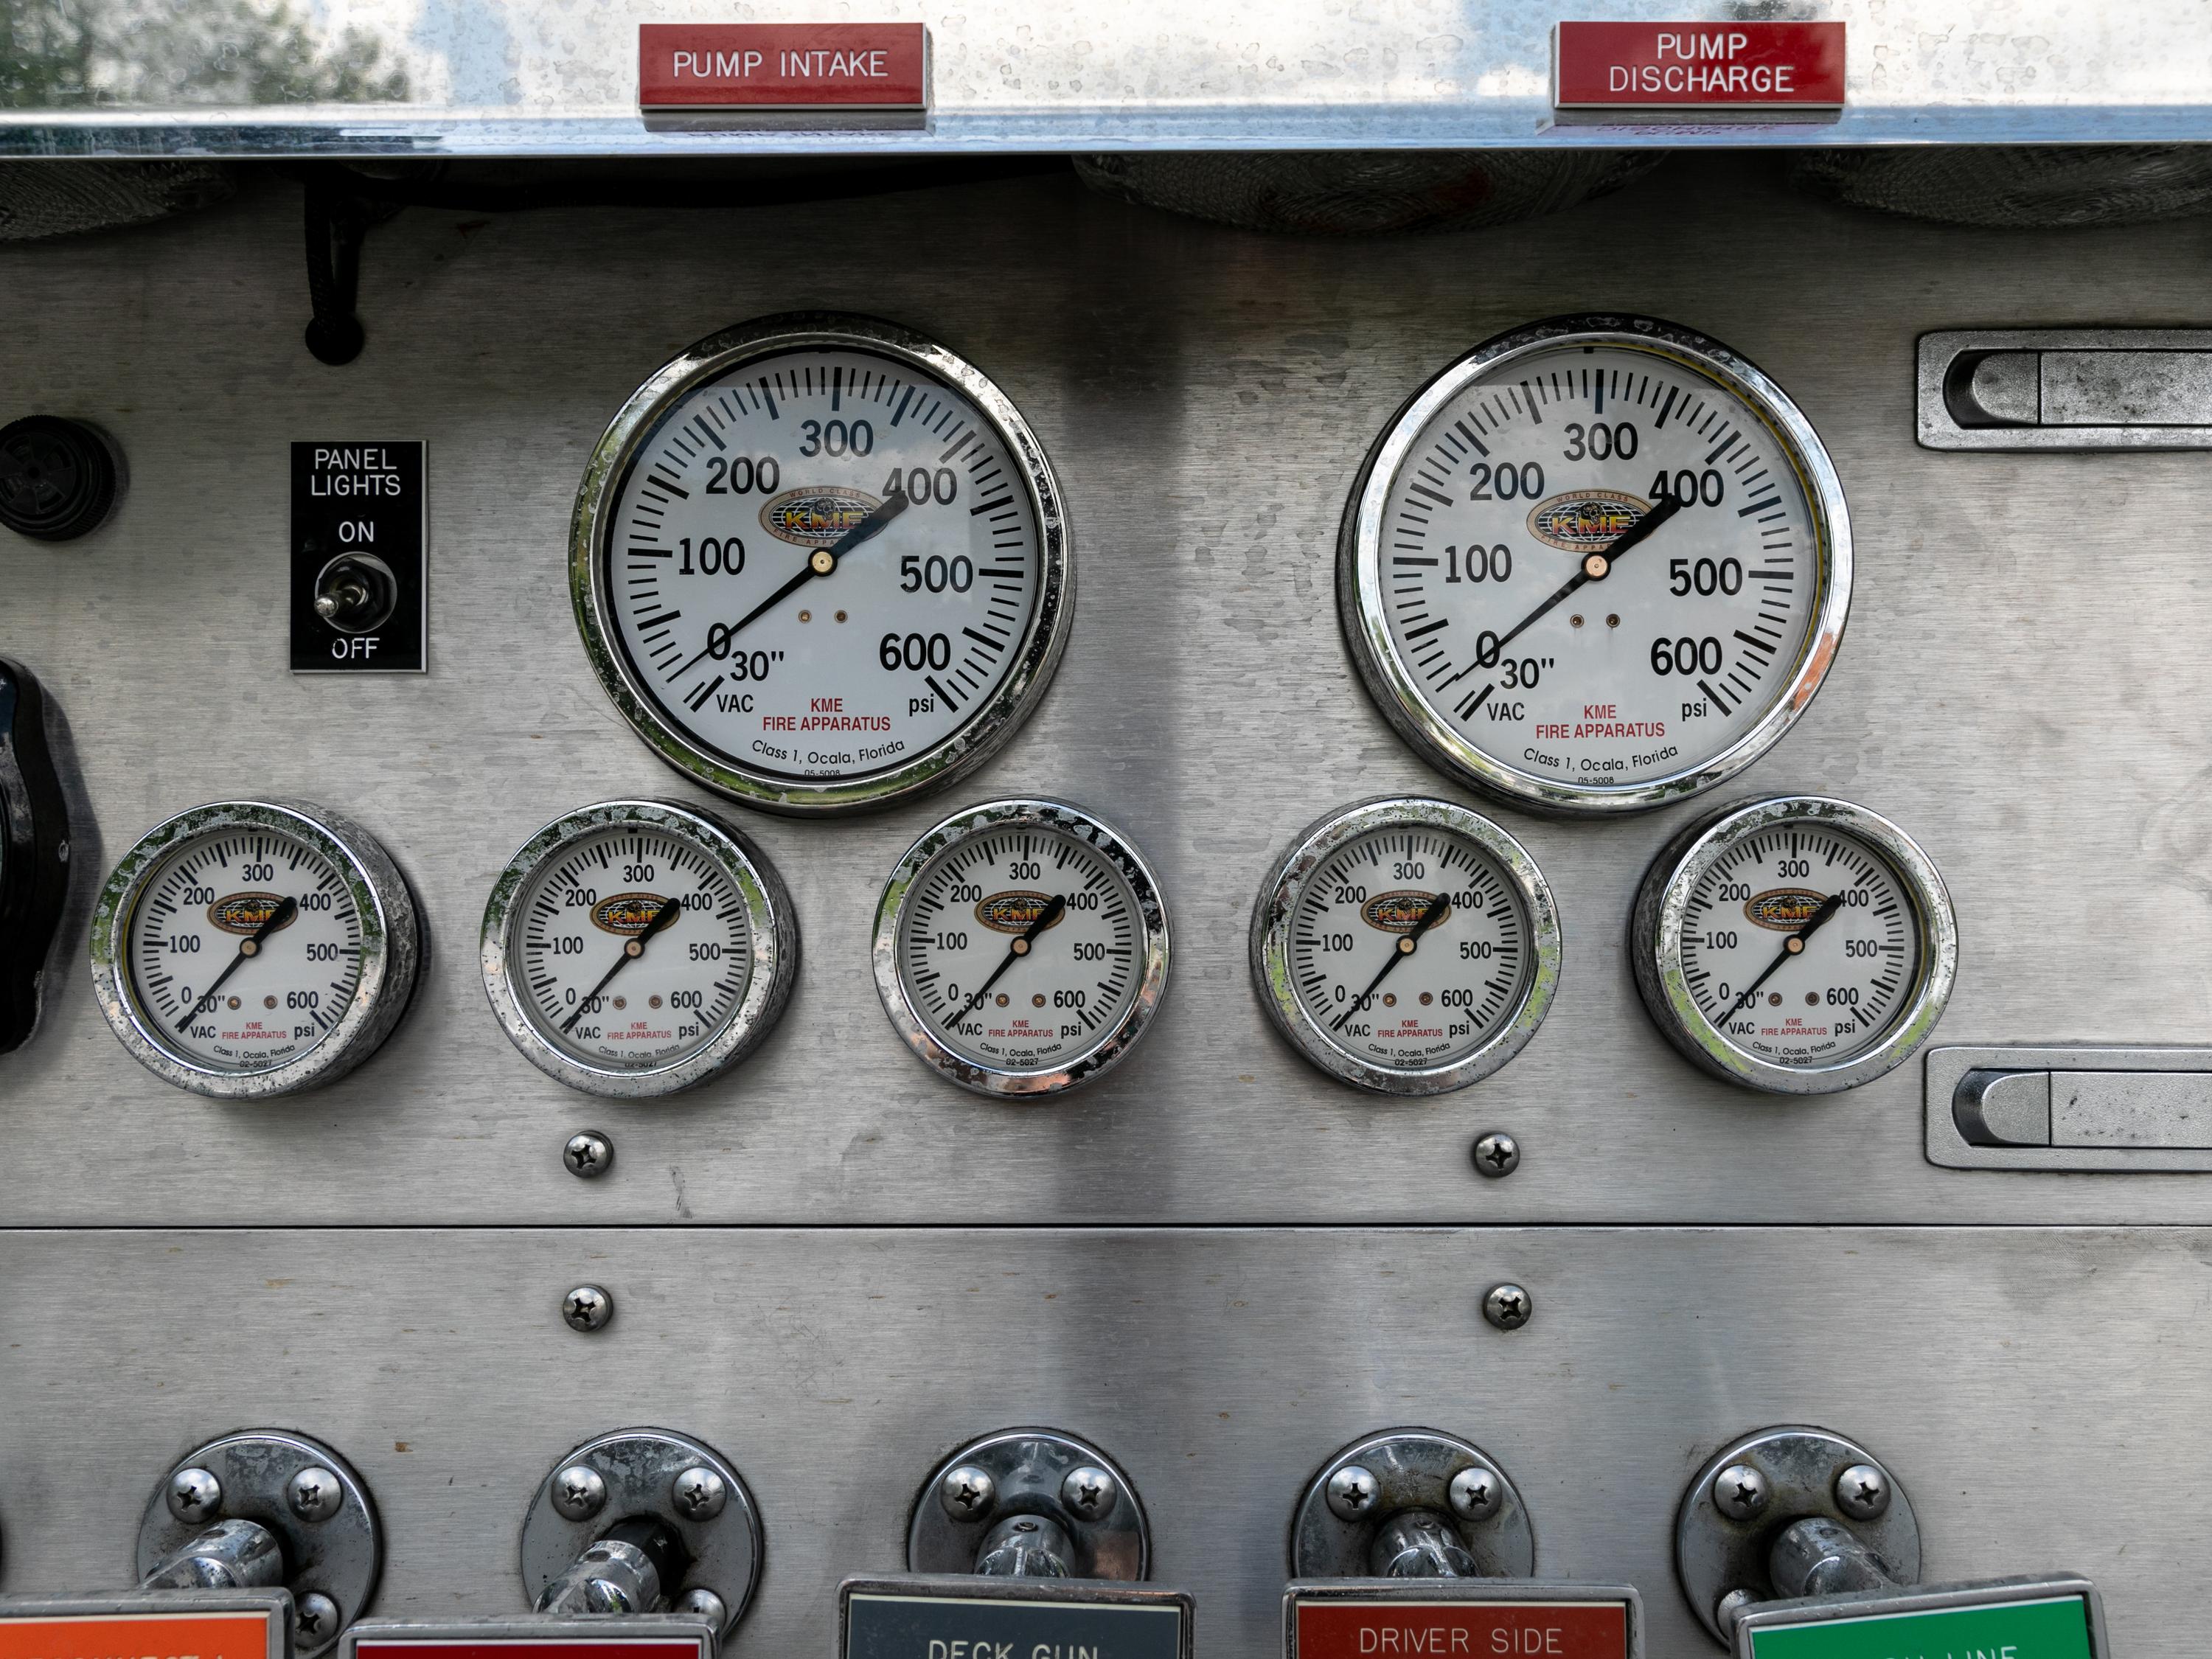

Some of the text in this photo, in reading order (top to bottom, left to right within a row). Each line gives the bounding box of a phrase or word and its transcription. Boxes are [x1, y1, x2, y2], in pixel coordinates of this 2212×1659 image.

[1657, 32, 1747, 60] PUMP
[673, 50, 888, 77] PUMP INTAKE
[1610, 66, 1795, 93] DISCHARGE
[799, 418, 874, 458] 300
[1562, 422, 1638, 461] 300
[315, 448, 397, 470] PANEL
[706, 456, 779, 495] 200
[1469, 462, 1545, 501] 200
[311, 475, 401, 496] LIGHTS
[789, 488, 860, 498] WORLD CLASS
[882, 467, 957, 505] 400
[1648, 469, 1724, 508] 400
[1557, 493, 1629, 503] WORLD CLASS
[785, 511, 863, 529] KME
[1552, 515, 1630, 535] KME
[338, 521, 374, 543] ON
[774, 529, 798, 542] FIRE
[1541, 535, 1565, 548] FIRE
[678, 537, 745, 576] 100
[1444, 544, 1512, 583] 100
[900, 554, 973, 594] 500
[1669, 557, 1742, 597] 500
[332, 637, 380, 659] OFF
[707, 622, 731, 661] 0
[1475, 630, 1500, 669] 0
[879, 633, 951, 671] 600
[1650, 636, 1723, 675] 600
[716, 692, 754, 713] VAC
[810, 697, 844, 713] KME
[908, 695, 935, 717] psi
[1487, 701, 1525, 721] VAC
[1681, 700, 1708, 722] psi
[1583, 704, 1617, 720] KME
[762, 716, 891, 731] FIRE APPARATUS
[1535, 722, 1666, 739] FIRE APPARATUS
[752, 740, 905, 765] Class 1, Ocala, Florida
[1524, 746, 1678, 772] Class 1, Ocala, Florida
[242, 864, 274, 882] 300
[623, 865, 655, 883] 300
[1009, 862, 1041, 880] 300
[1393, 862, 1425, 880] 300
[1778, 860, 1809, 877] 300
[183, 887, 215, 905] 200
[566, 888, 597, 907] 200
[950, 885, 982, 902] 200
[1335, 886, 1366, 904] 200
[1452, 891, 1483, 909] 400
[1719, 883, 1750, 902] 200
[1840, 889, 1869, 907] 400
[299, 893, 331, 911] 400
[681, 893, 712, 911] 400
[1067, 893, 1099, 911] 400
[170, 935, 201, 953] 100
[553, 936, 584, 954] 100
[936, 932, 967, 950] 100
[1322, 933, 1353, 952] 100
[1706, 931, 1737, 949] 100
[1846, 939, 1877, 957] 500
[307, 944, 338, 961] 500
[689, 943, 721, 961] 500
[1074, 943, 1105, 961] 500
[1460, 942, 1492, 959] 500
[181, 987, 192, 1004] 0
[566, 988, 576, 1005] 0
[671, 991, 703, 1008] 600
[948, 984, 959, 1001] 0
[1054, 990, 1085, 1008] 600
[1335, 984, 1346, 1002] 0
[1441, 990, 1473, 1007] 600
[1719, 982, 1729, 1000] 0
[1826, 987, 1859, 1006] 600
[287, 992, 319, 1009] 600
[190, 1026, 216, 1039] VAC
[241, 1031, 287, 1039] APPARATUS
[294, 1023, 315, 1040] psi
[575, 1026, 601, 1040] VAC
[626, 1031, 672, 1040] APPARATUS
[679, 1022, 700, 1040] psi
[957, 1023, 983, 1036] VAC
[1061, 1021, 1082, 1039] psi
[1344, 1024, 1371, 1037] VAC
[1449, 1020, 1470, 1037] psi
[1729, 1022, 1755, 1034] VAC
[1834, 1020, 1855, 1037] psi
[214, 1046, 232, 1056] Class
[271, 1045, 295, 1057] Florida
[980, 1043, 999, 1054] Class
[1002, 1048, 1007, 1057] 1,
[1037, 1043, 1062, 1055] Florida
[1368, 1043, 1388, 1054] Class
[1391, 1048, 1396, 1057] 1,
[1425, 1043, 1450, 1055] Florida
[1753, 1041, 1772, 1053] Class
[1775, 1046, 1780, 1055] 1,
[1811, 1041, 1836, 1054] Florida
[929, 1640, 1014, 1659] DECK
[1359, 1627, 1563, 1654] DRIVER SIDE
